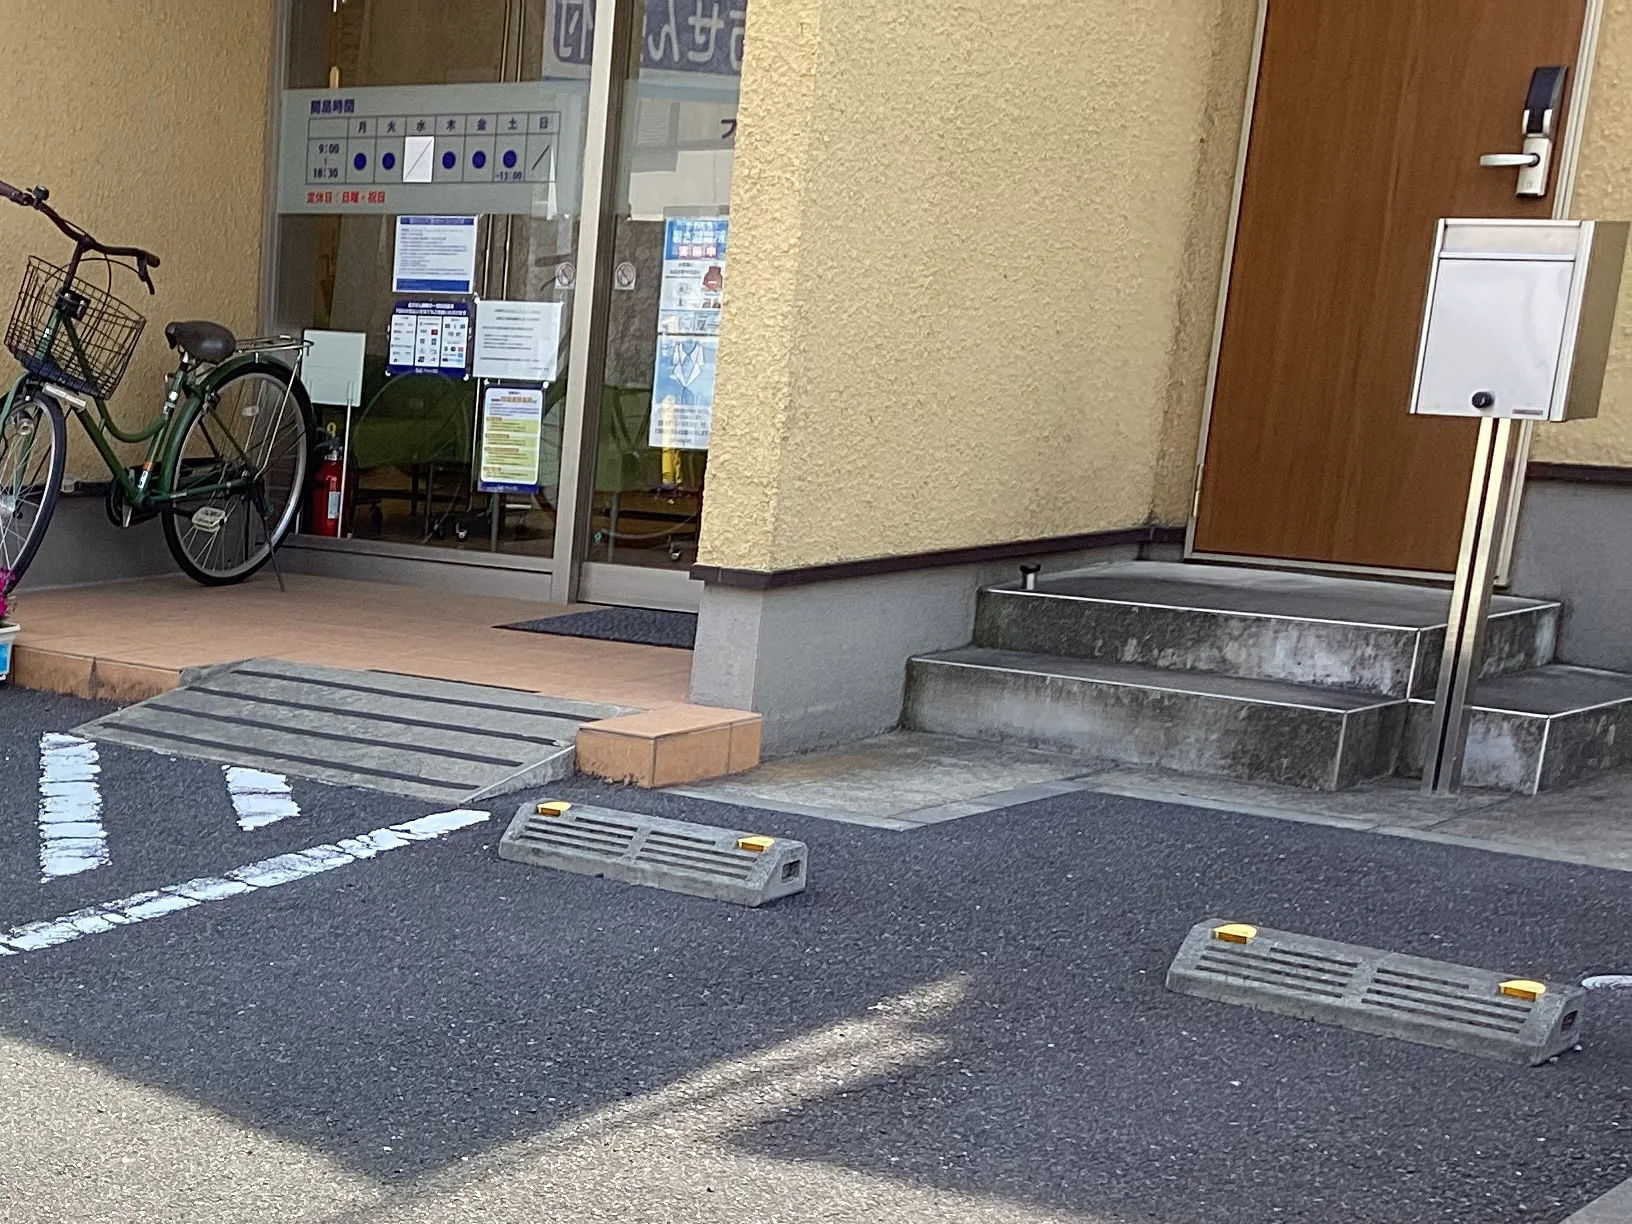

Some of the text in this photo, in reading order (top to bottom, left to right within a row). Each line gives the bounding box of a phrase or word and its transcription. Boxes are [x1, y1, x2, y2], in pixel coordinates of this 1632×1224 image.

[357, 115, 549, 134] 月 火 水 木 金 土 日
